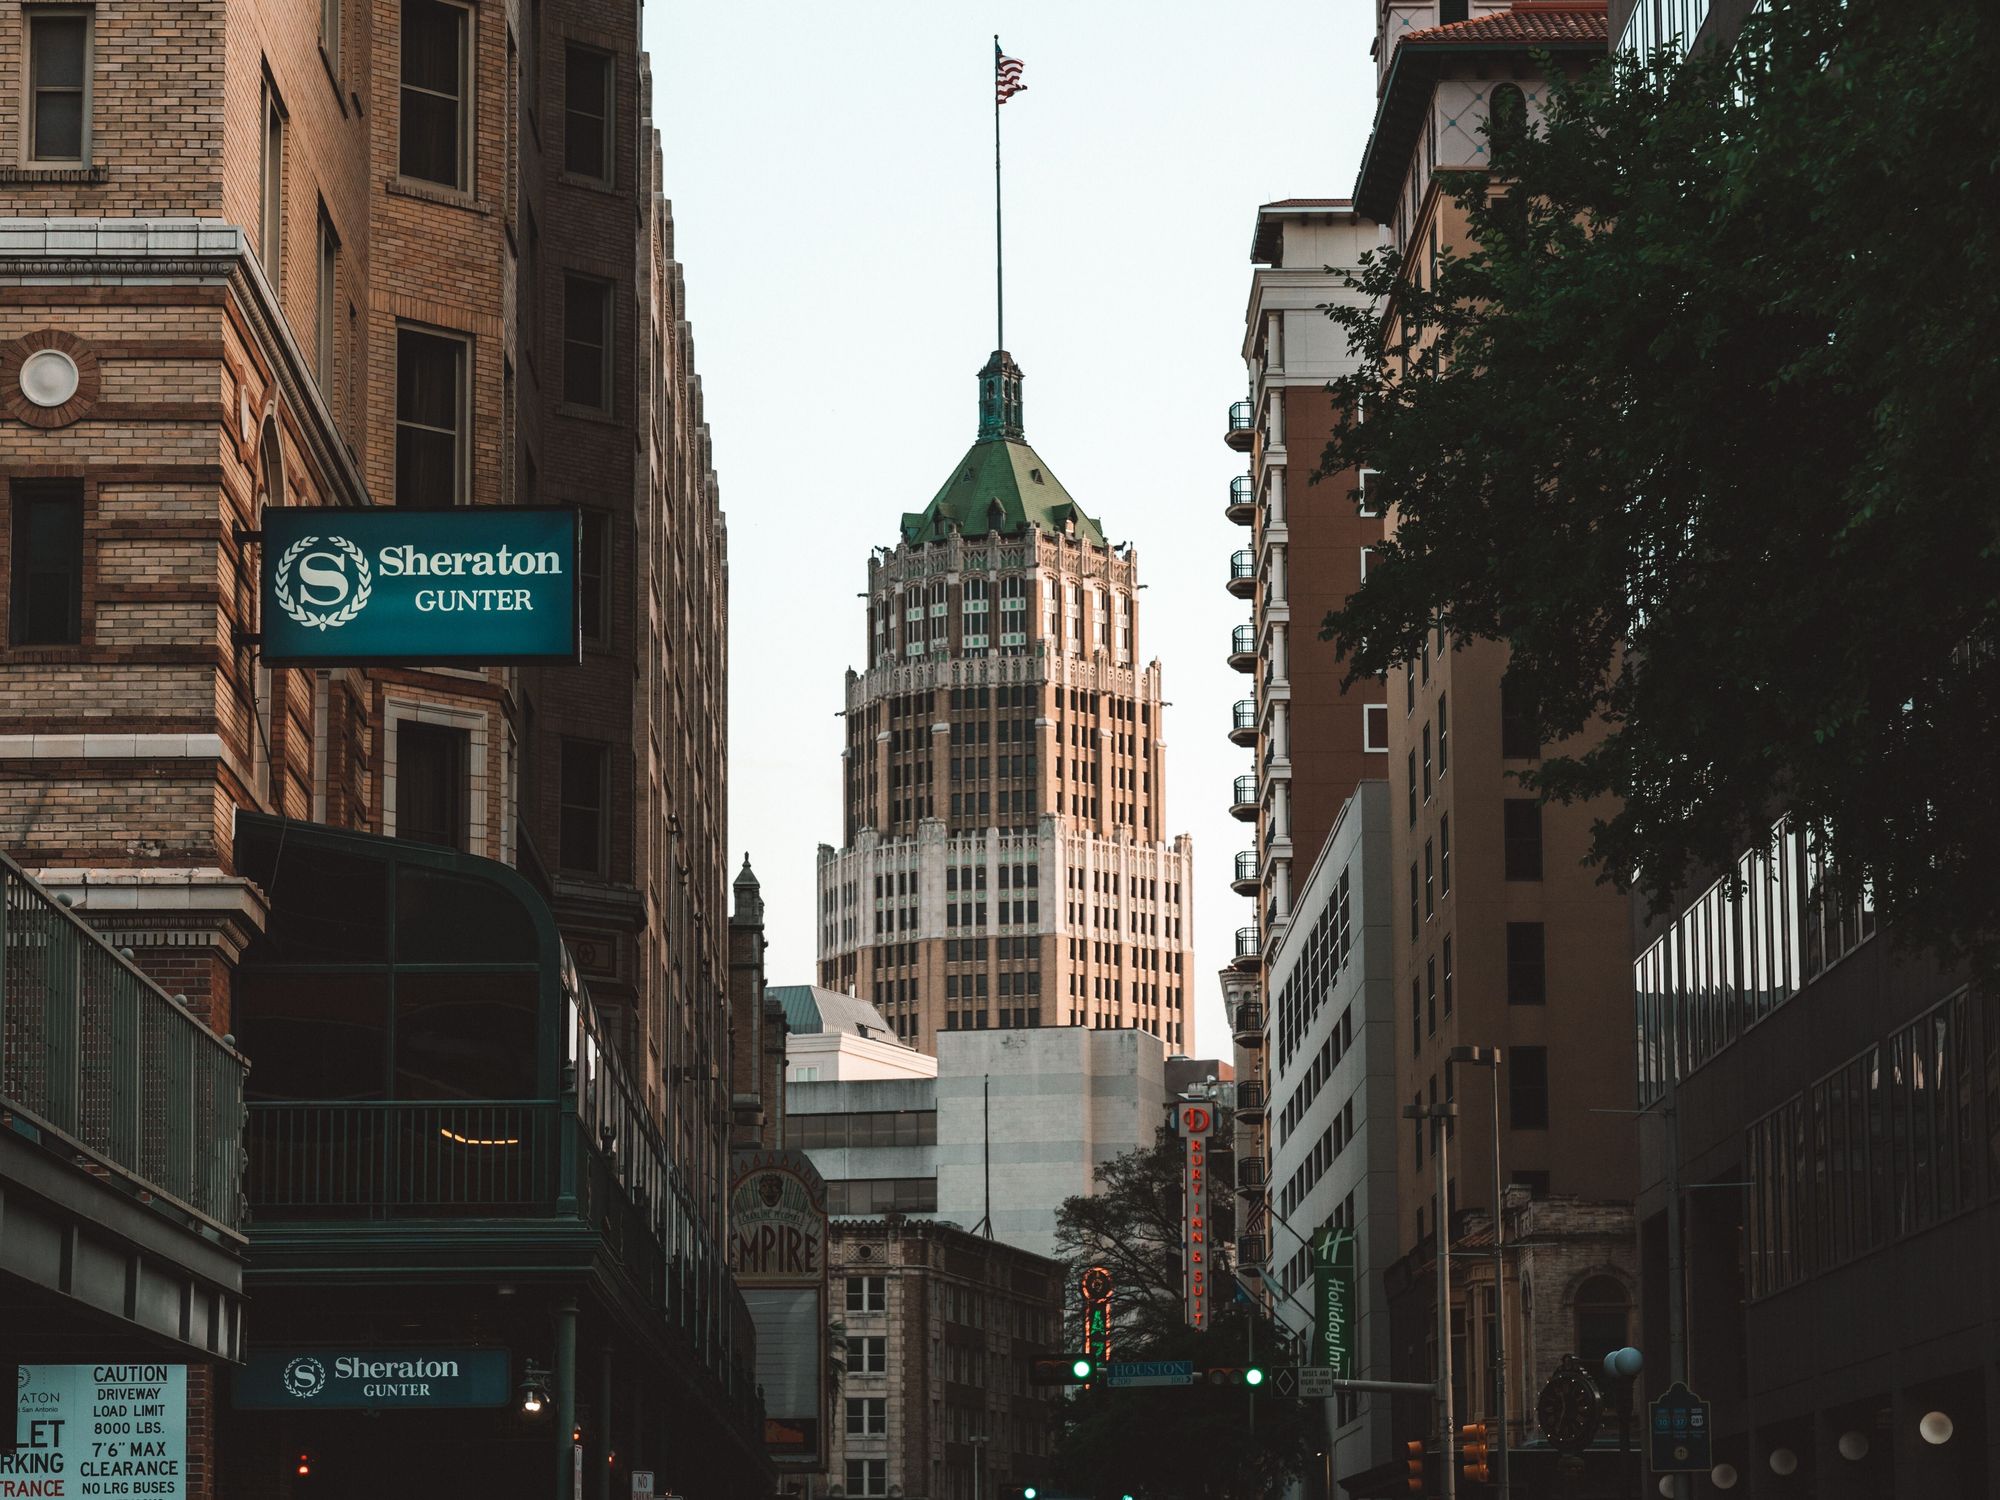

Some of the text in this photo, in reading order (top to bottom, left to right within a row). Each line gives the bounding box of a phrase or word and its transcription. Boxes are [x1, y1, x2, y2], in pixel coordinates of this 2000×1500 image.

[379, 543, 563, 577] Sheraton
[415, 589, 533, 612] GUNTER
[1191, 1202, 1204, 1244] INN
[1325, 1278, 1345, 1344] Holiday
[94, 1366, 167, 1382] CAUTION
[335, 1356, 459, 1379] Sheraton
[1113, 1361, 1185, 1377] HOUSTON
[98, 1388, 161, 1400] DRIVEWAY
[363, 1383, 431, 1397] GUNTER
[93, 1404, 165, 1417] LOAD LIMIT
[94, 1422, 165, 1435] 8000 LBS.
[130, 1441, 166, 1457] MAX
[80, 1461, 178, 1477] CLEARANCE
[0, 1480, 65, 1498] RANCE
[82, 1481, 175, 1494] NO LRG BUSES
[637, 1476, 648, 1489] NO
